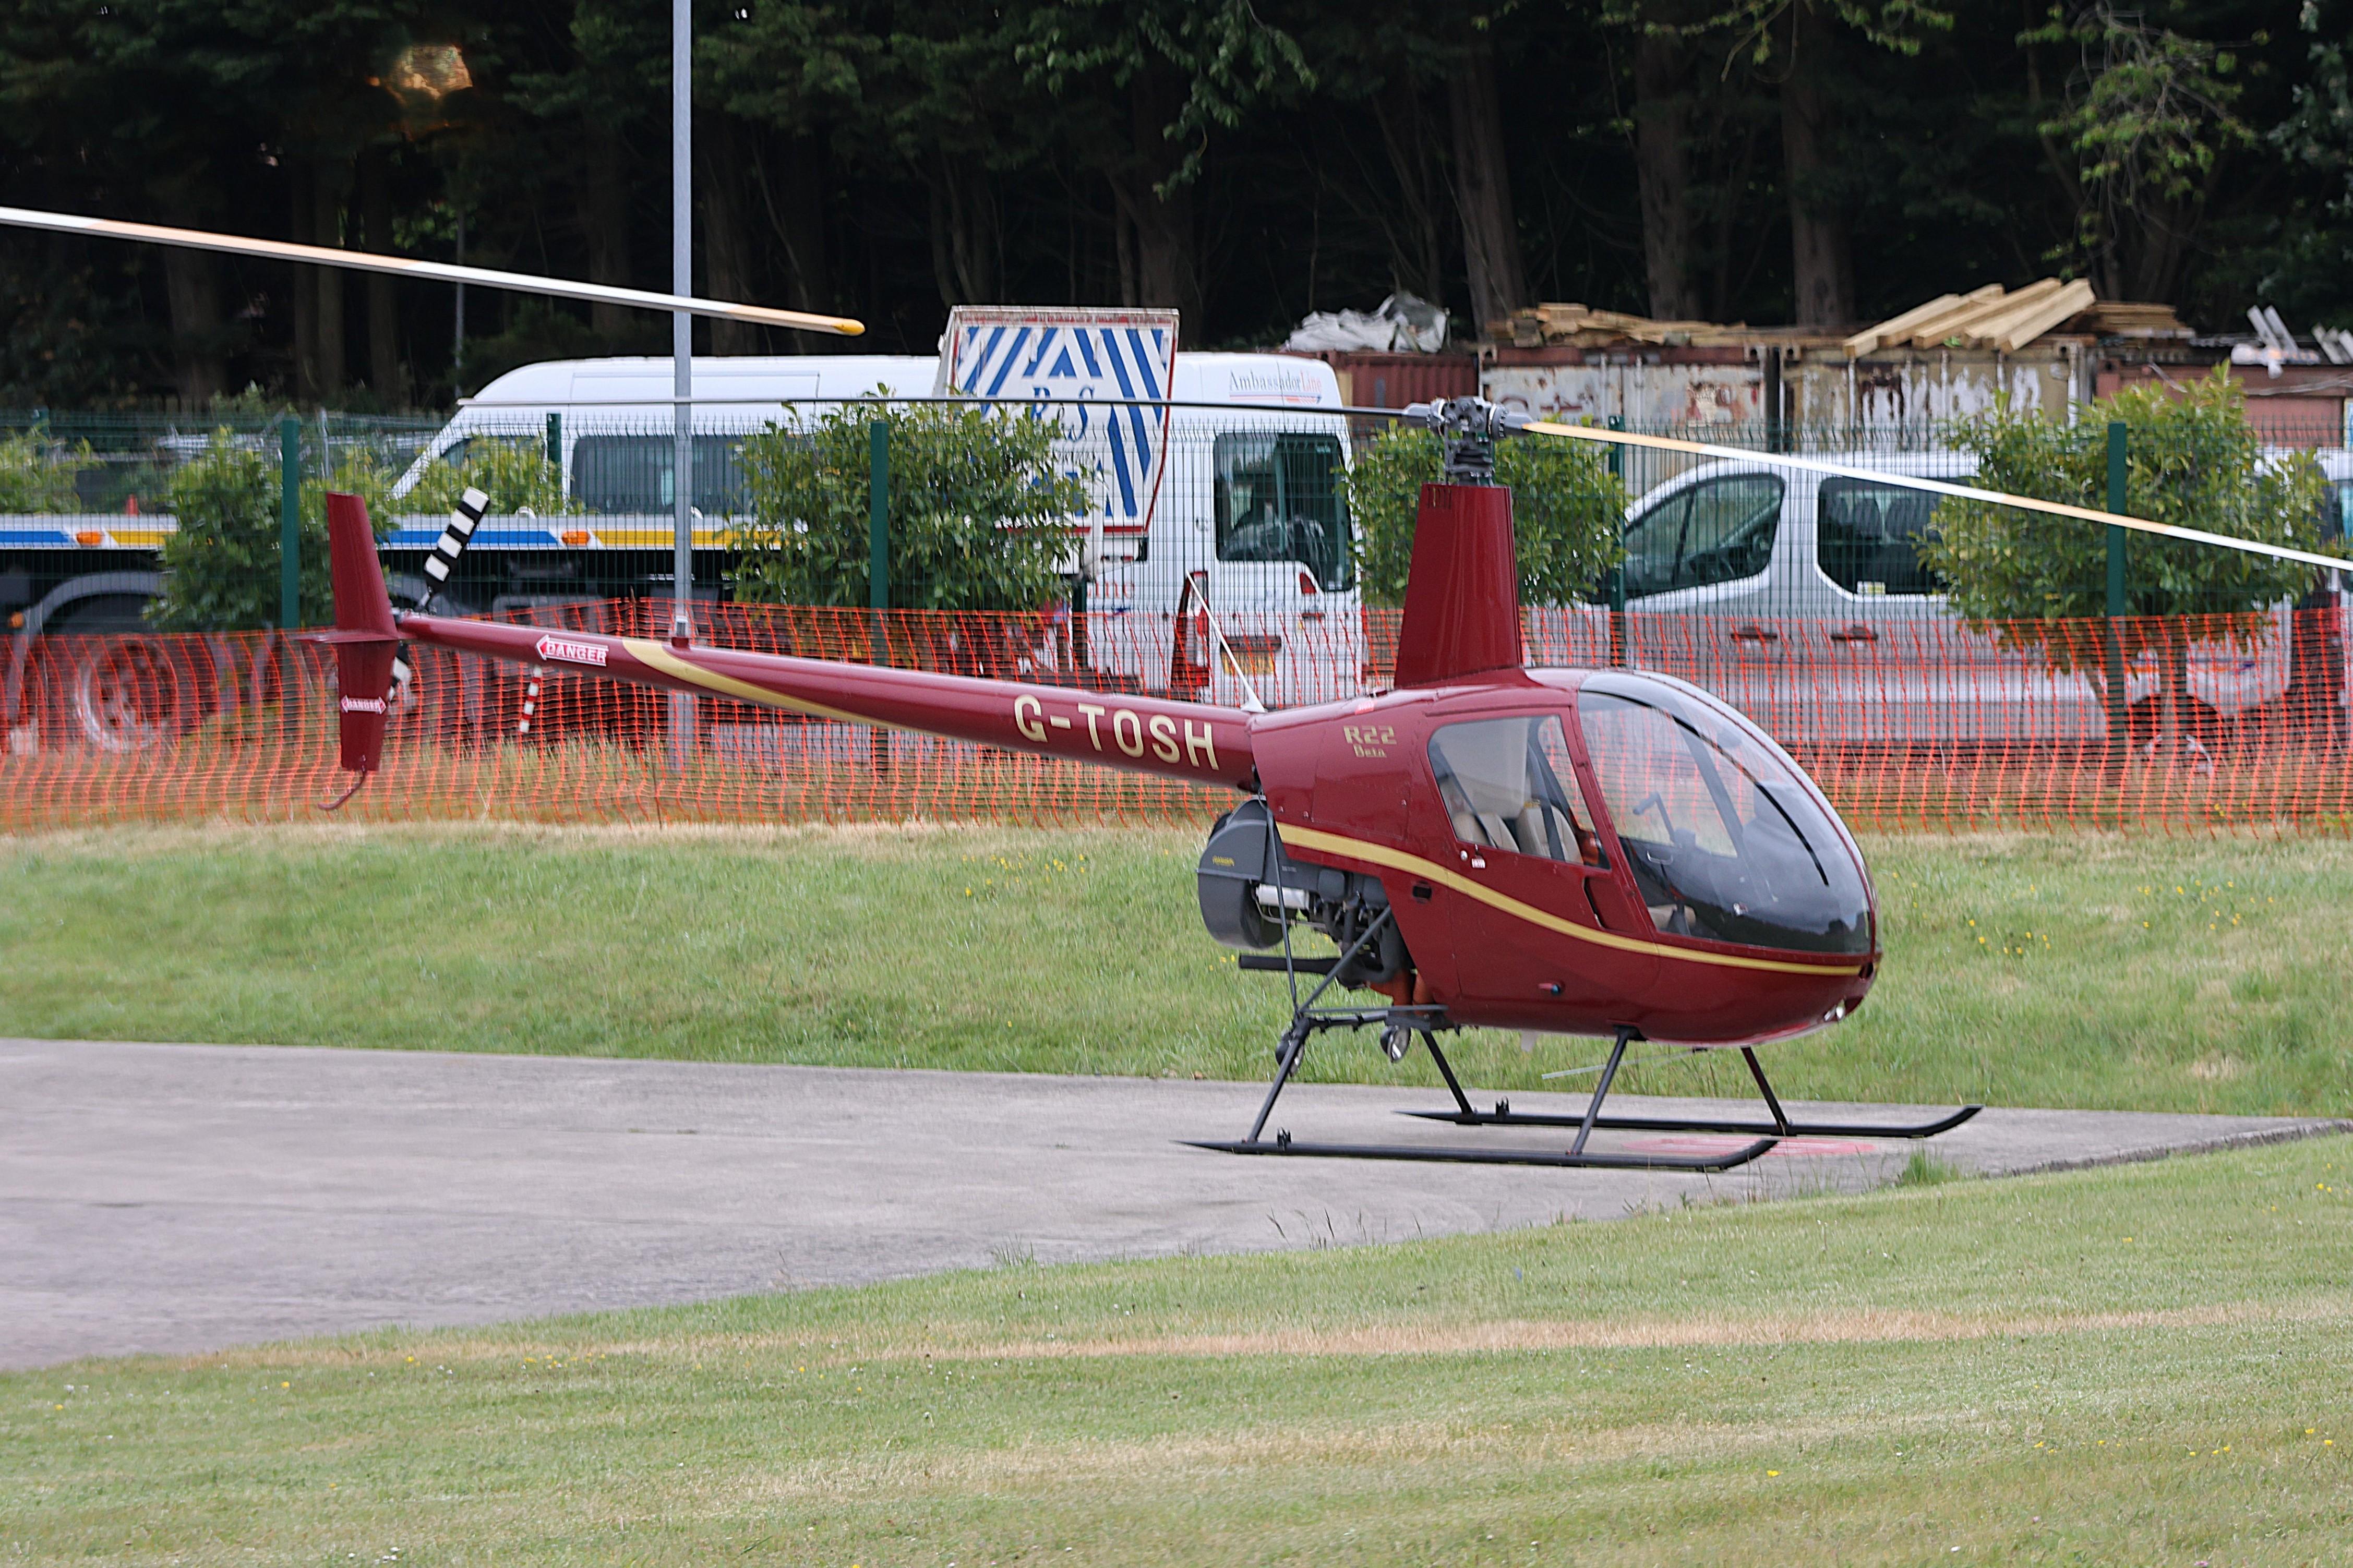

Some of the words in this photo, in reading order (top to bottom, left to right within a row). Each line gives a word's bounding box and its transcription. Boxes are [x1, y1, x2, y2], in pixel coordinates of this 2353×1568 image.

[546, 642, 607, 664] DANGER
[1014, 694, 1219, 770] G-TOSH
[1343, 726, 1397, 745] R22
